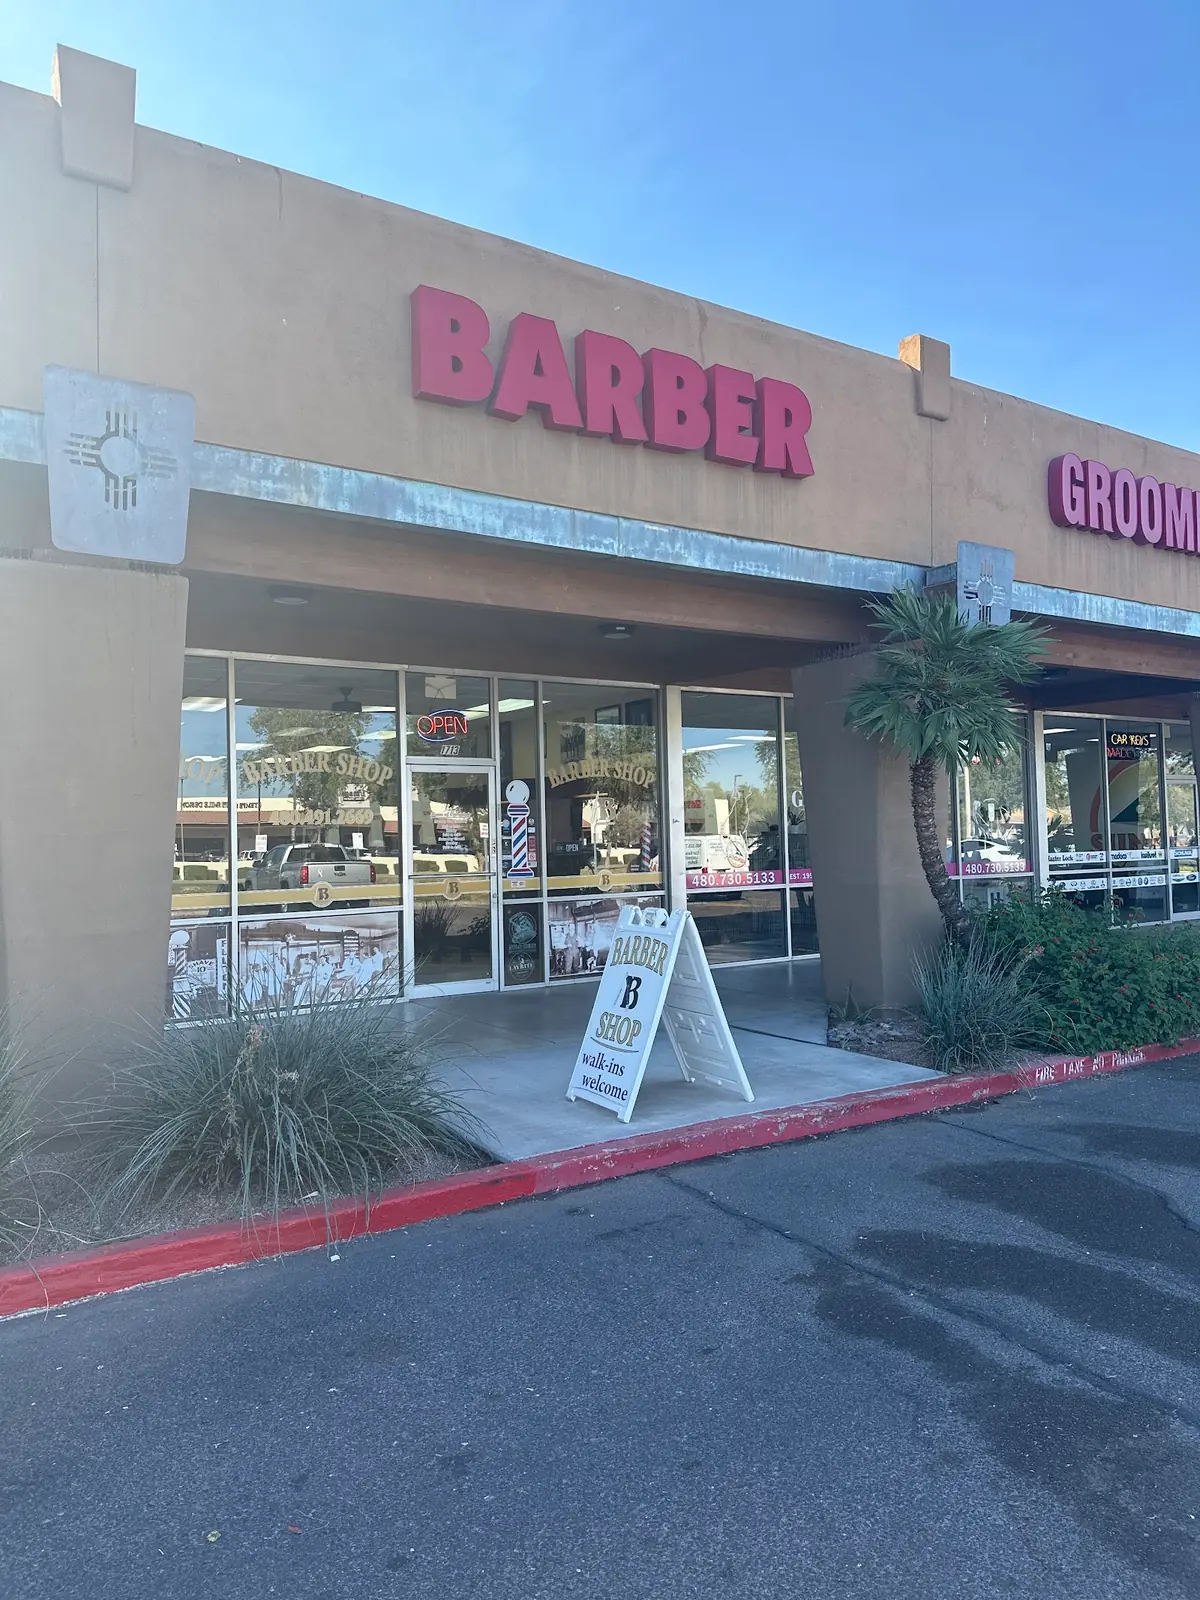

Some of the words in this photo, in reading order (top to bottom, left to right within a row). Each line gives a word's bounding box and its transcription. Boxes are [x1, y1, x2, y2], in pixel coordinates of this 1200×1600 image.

[410, 284, 815, 479] BARBER
[417, 714, 469, 736] OPEN
[1111, 733, 1128, 745] CAR
[1129, 735, 1149, 746] KEYS
[440, 744, 460, 755] 1713
[243, 751, 332, 785] BARBER
[336, 752, 393, 787] SHOP
[547, 759, 611, 788] BARBER
[613, 761, 656, 789] SHOP
[269, 808, 375, 826] 480.491.2669
[565, 842, 579, 853] OPEN
[965, 861, 1026, 874] 480.730.5133
[449, 881, 459, 893] B
[602, 874, 610, 885] B
[692, 871, 775, 887] 480.730.5133
[318, 887, 329, 900] B
[610, 935, 668, 977] BARBER
[619, 975, 642, 1010] B
[595, 1011, 642, 1047] SHOP
[582, 1052, 625, 1077] walk-ins
[1036, 1066, 1055, 1082] FIRE
[582, 1074, 628, 1101] welcome
